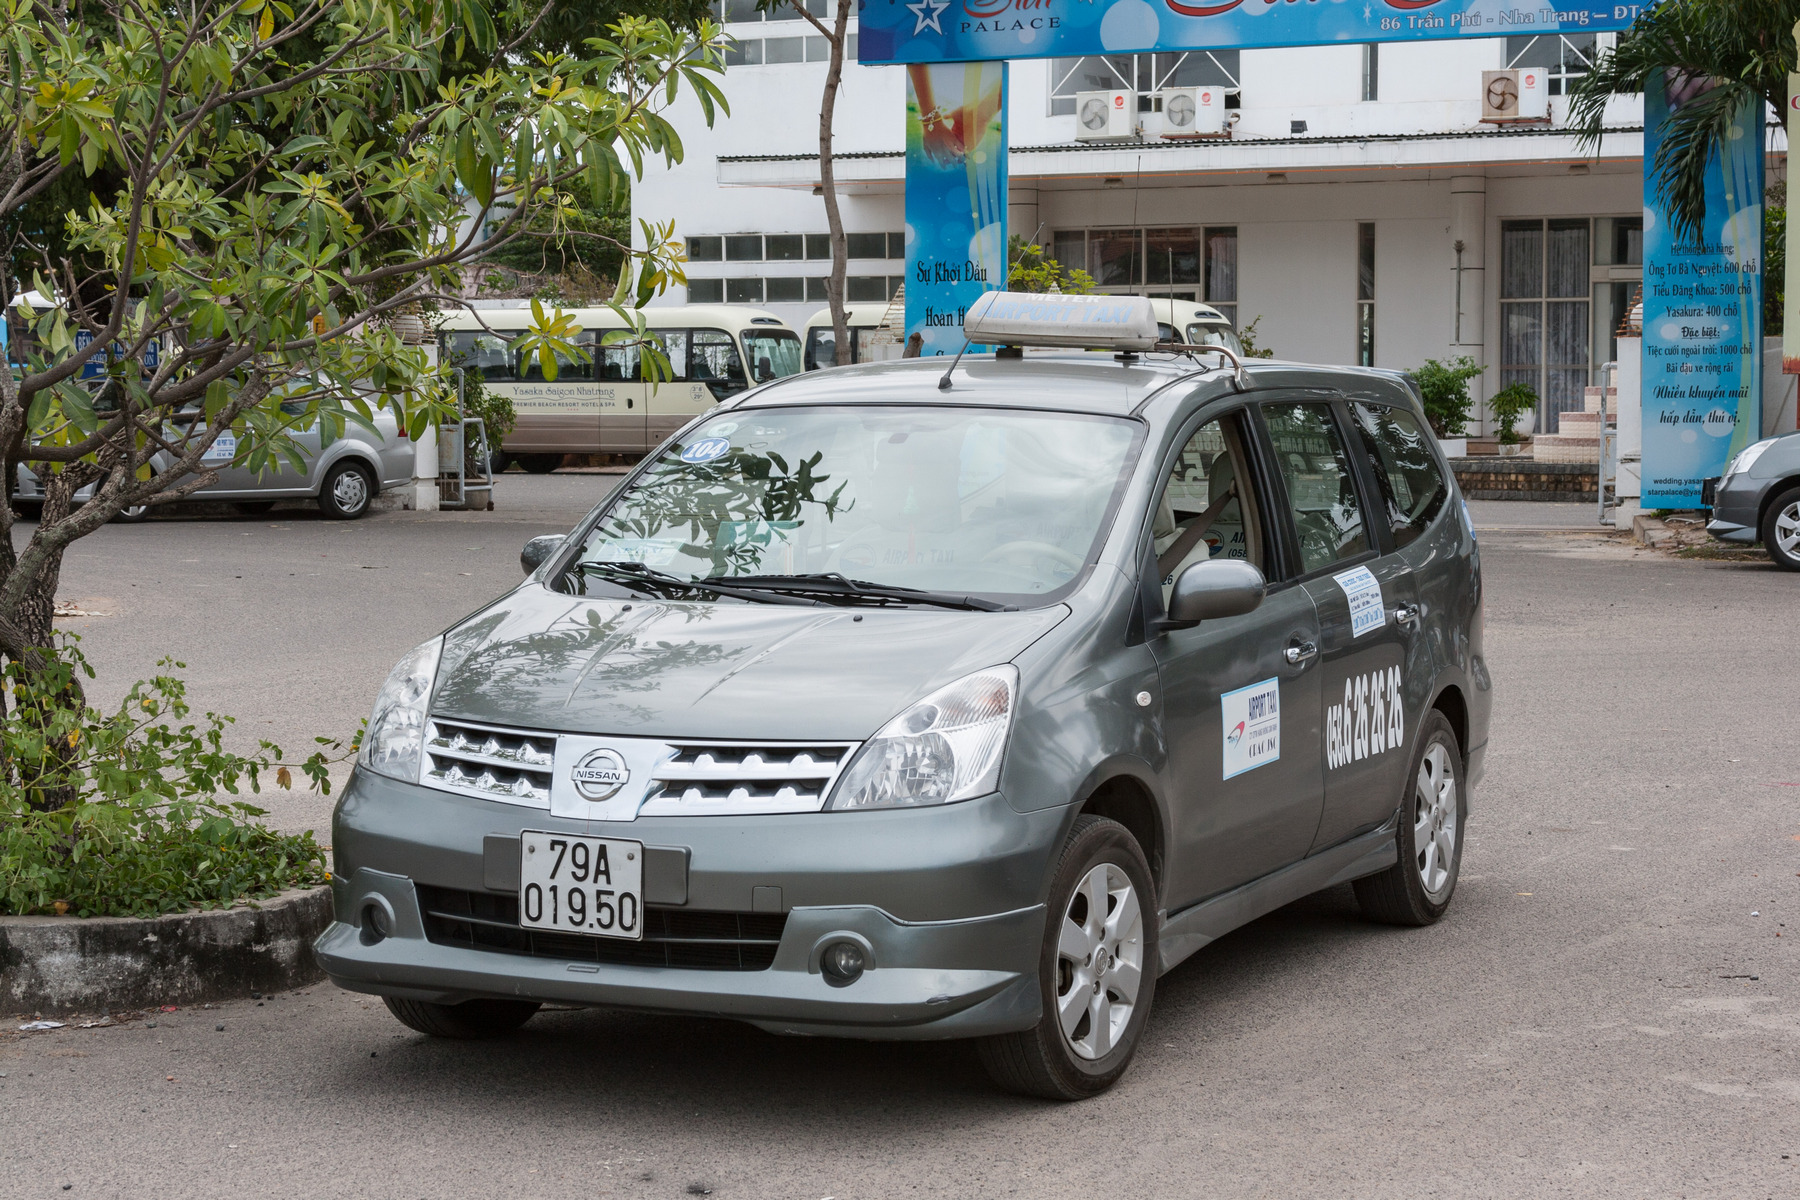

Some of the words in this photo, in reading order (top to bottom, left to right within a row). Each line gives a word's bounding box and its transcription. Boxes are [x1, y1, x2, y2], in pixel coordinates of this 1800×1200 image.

[960, 17, 1061, 33] PALACE
[1380, 16, 1401, 31] 86
[1406, 11, 1444, 30] Trần
[1450, 10, 1482, 28] Phú
[1499, 9, 1534, 25] Nha
[1539, 7, 1590, 26] Trang
[917, 260, 931, 286] Sự
[935, 260, 960, 286] Khởi
[965, 260, 988, 282] Đầu
[1648, 261, 1665, 279] Ông
[1679, 262, 1689, 275] Bà
[1691, 260, 1722, 278] Nguyệt:
[1724, 262, 1739, 274] 600
[1653, 281, 1670, 296] Tiểu
[1695, 282, 1718, 296] Khoa:
[1720, 284, 1735, 296] 500
[1025, 292, 1102, 303] METER
[925, 306, 954, 326] Hoàn
[977, 301, 1077, 322] AIRPORT
[1081, 304, 1134, 324] TAXI
[1666, 305, 1704, 318] Yasakura:
[1706, 306, 1721, 317] 400
[1647, 345, 1662, 359] Tiệc
[1681, 345, 1700, 358] ngoài
[1720, 345, 1738, 355] 1000
[1680, 362, 1693, 374] đậu
[1705, 364, 1721, 376] rộng
[512, 386, 543, 396] Yasaka
[545, 386, 575, 398] Saigon
[576, 386, 616, 398] Nhatrang
[1652, 384, 1686, 399] Nhiều
[1688, 385, 1726, 401] khuyến
[1728, 386, 1749, 398] mãi
[1659, 410, 1680, 426] hấp
[1682, 408, 1705, 424] dẫn,
[1708, 410, 1725, 424] thú
[683, 441, 727, 458] 104
[1653, 478, 1702, 486] wedding.yasa
[1647, 488, 1702, 496] starpalace@yas
[1267, 690, 1277, 714] TAXI
[1326, 677, 1352, 770] 058.6
[1354, 674, 1368, 761] 26
[1371, 670, 1385, 755] 26
[1387, 664, 1404, 748] 26
[576, 770, 621, 780] NISSAN
[549, 839, 612, 885] 79A
[524, 882, 637, 932] 019.50
